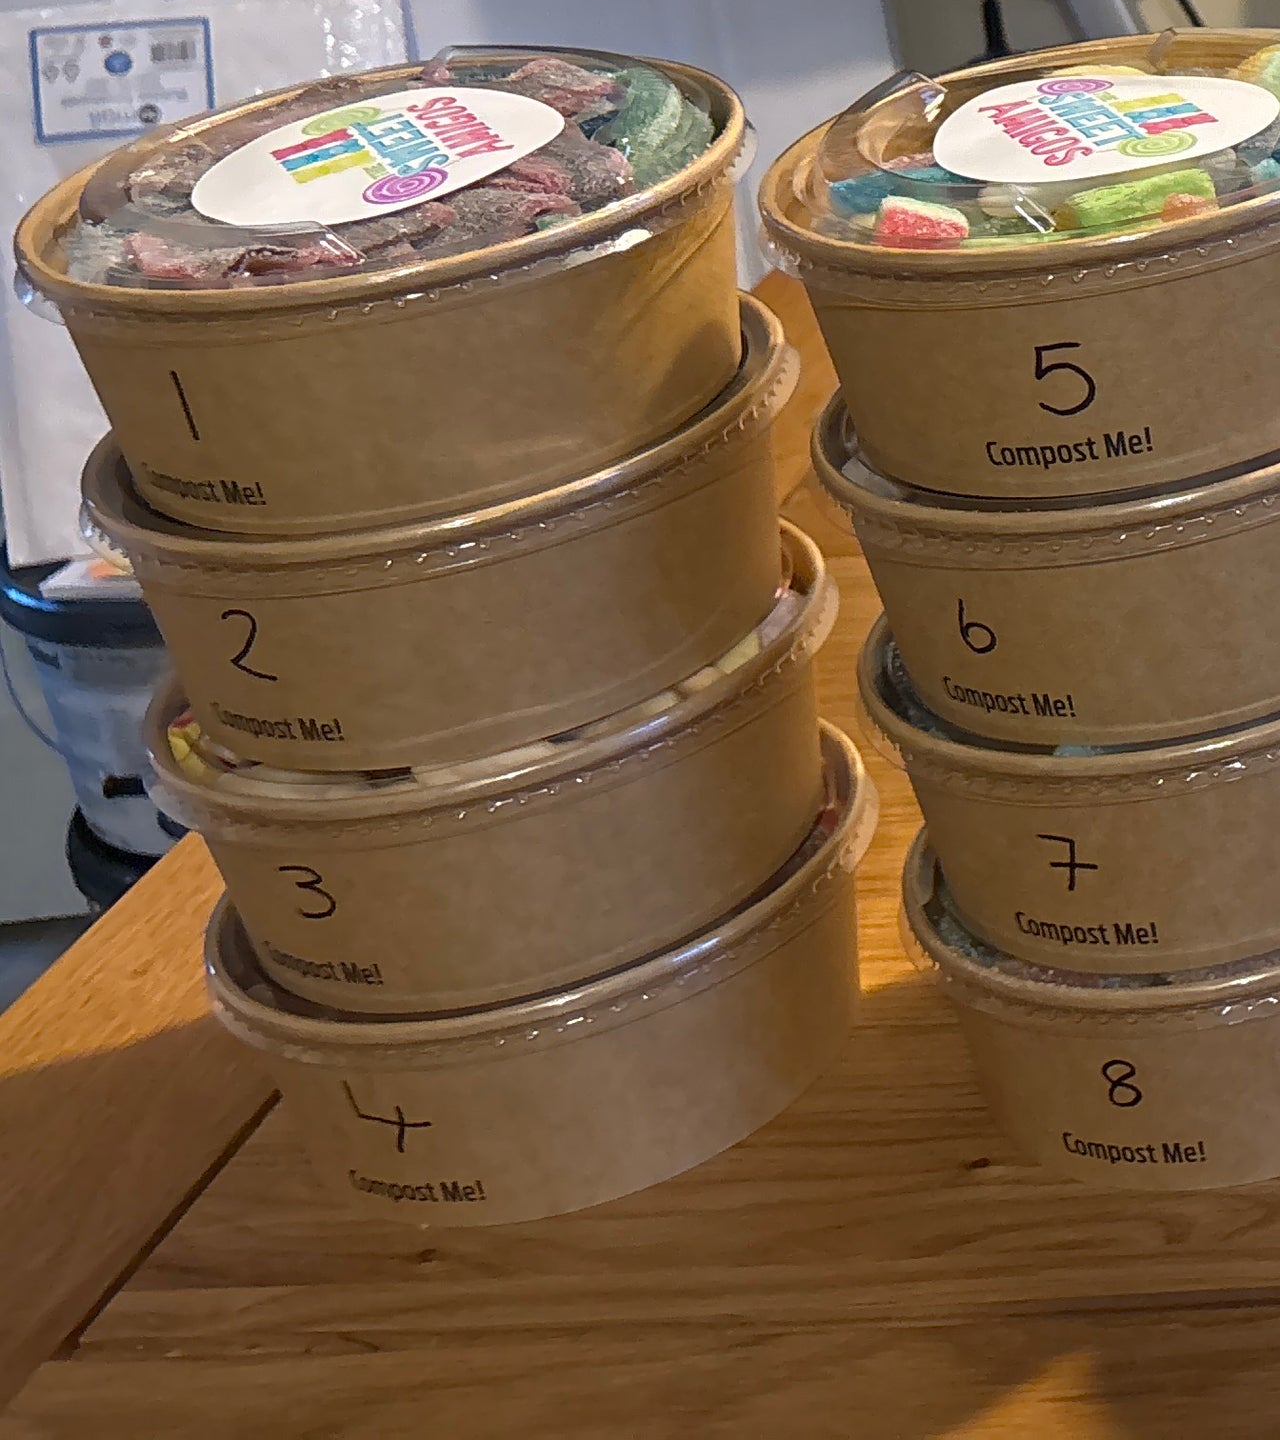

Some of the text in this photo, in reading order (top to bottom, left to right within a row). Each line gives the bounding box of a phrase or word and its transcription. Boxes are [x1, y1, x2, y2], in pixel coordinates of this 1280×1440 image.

[349, 114, 449, 176] SWEET
[407, 97, 514, 158] AMIGOS
[978, 100, 1092, 166] AMIGOS
[1038, 92, 1144, 146] SWEET
[170, 370, 200, 441] 1
[1034, 342, 1096, 416] 5
[985, 426, 1153, 470] Compost Me!
[220, 480, 267, 506] Me!
[221, 609, 278, 681] 2
[958, 598, 997, 654] 6
[942, 675, 1077, 718] Compost Me!
[298, 718, 345, 742] Me!
[1036, 834, 1099, 891] 7
[275, 865, 336, 919] 3
[1015, 911, 1159, 946] Compost Me!
[340, 961, 384, 986] Me!
[1101, 1059, 1143, 1108] 8
[342, 1080, 432, 1153] 4
[1062, 1132, 1207, 1164] Compost Me!
[440, 1180, 487, 1202] Me!
